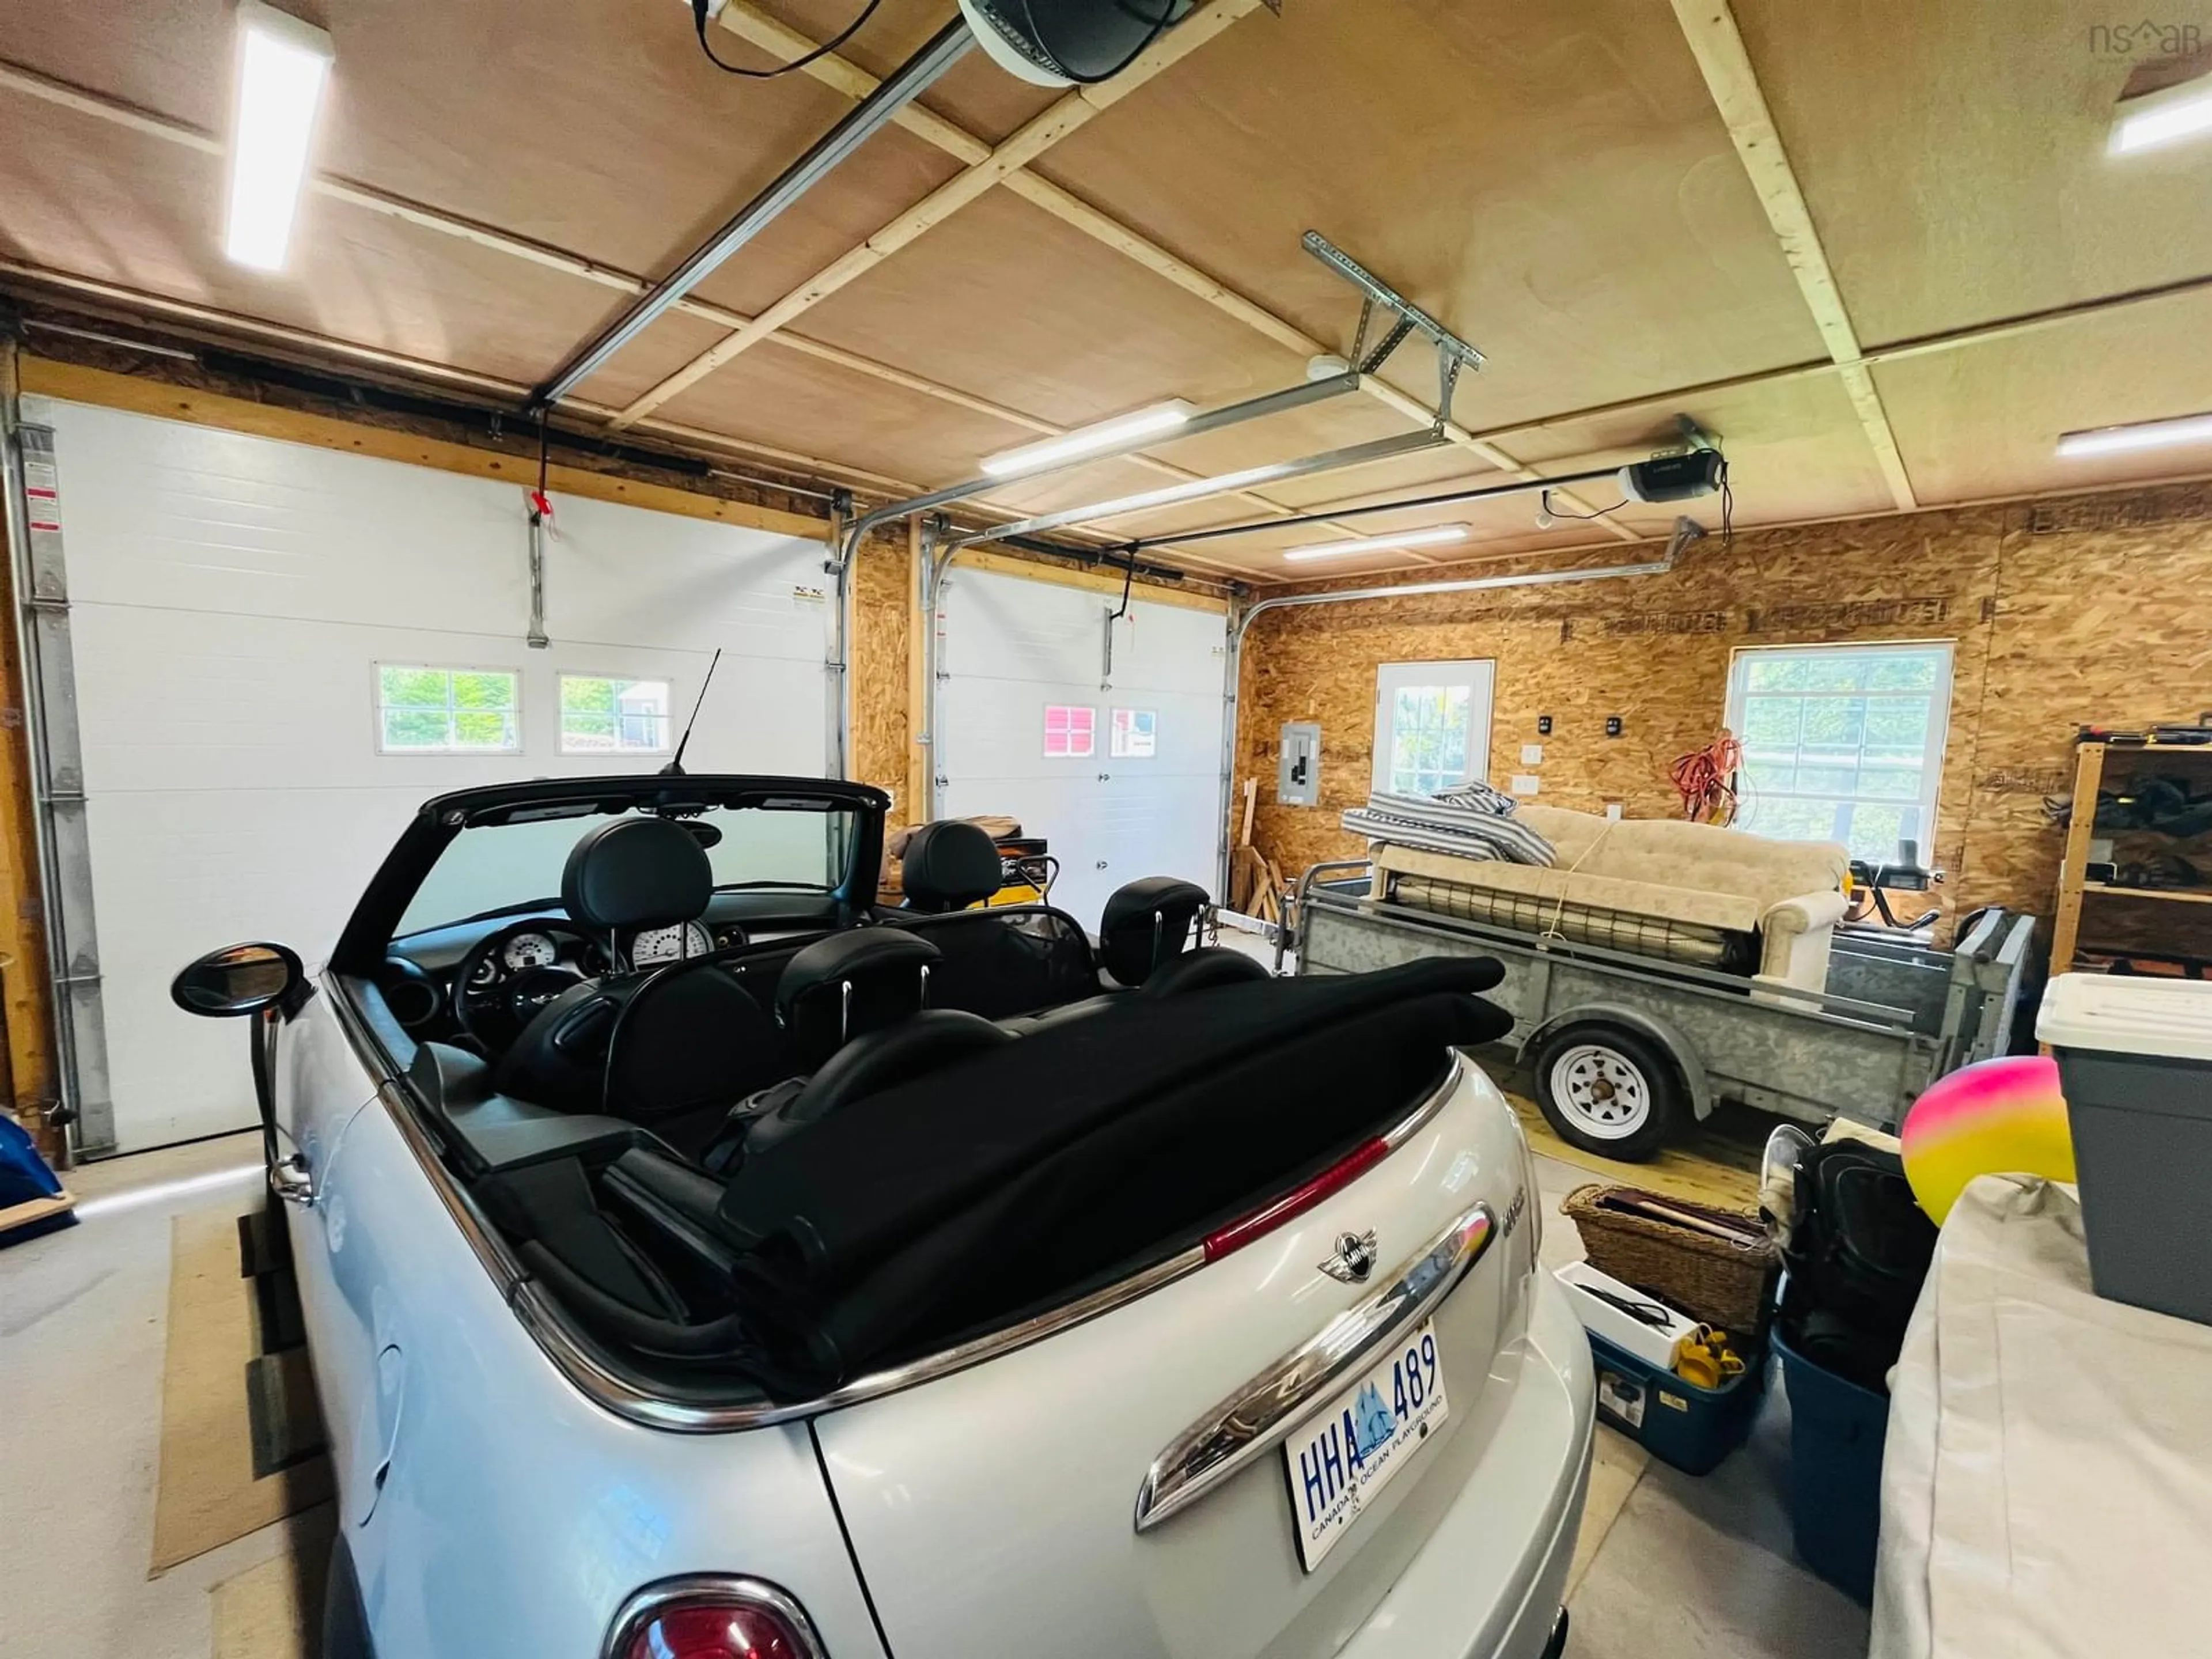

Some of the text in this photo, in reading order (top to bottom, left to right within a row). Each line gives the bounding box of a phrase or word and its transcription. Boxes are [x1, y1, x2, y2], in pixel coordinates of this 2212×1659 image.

[1300, 1334, 1436, 1522] HHA 489
[1360, 1449, 1389, 1485] OCEAN
[1392, 1395, 1442, 1450] PLAYGROUND
